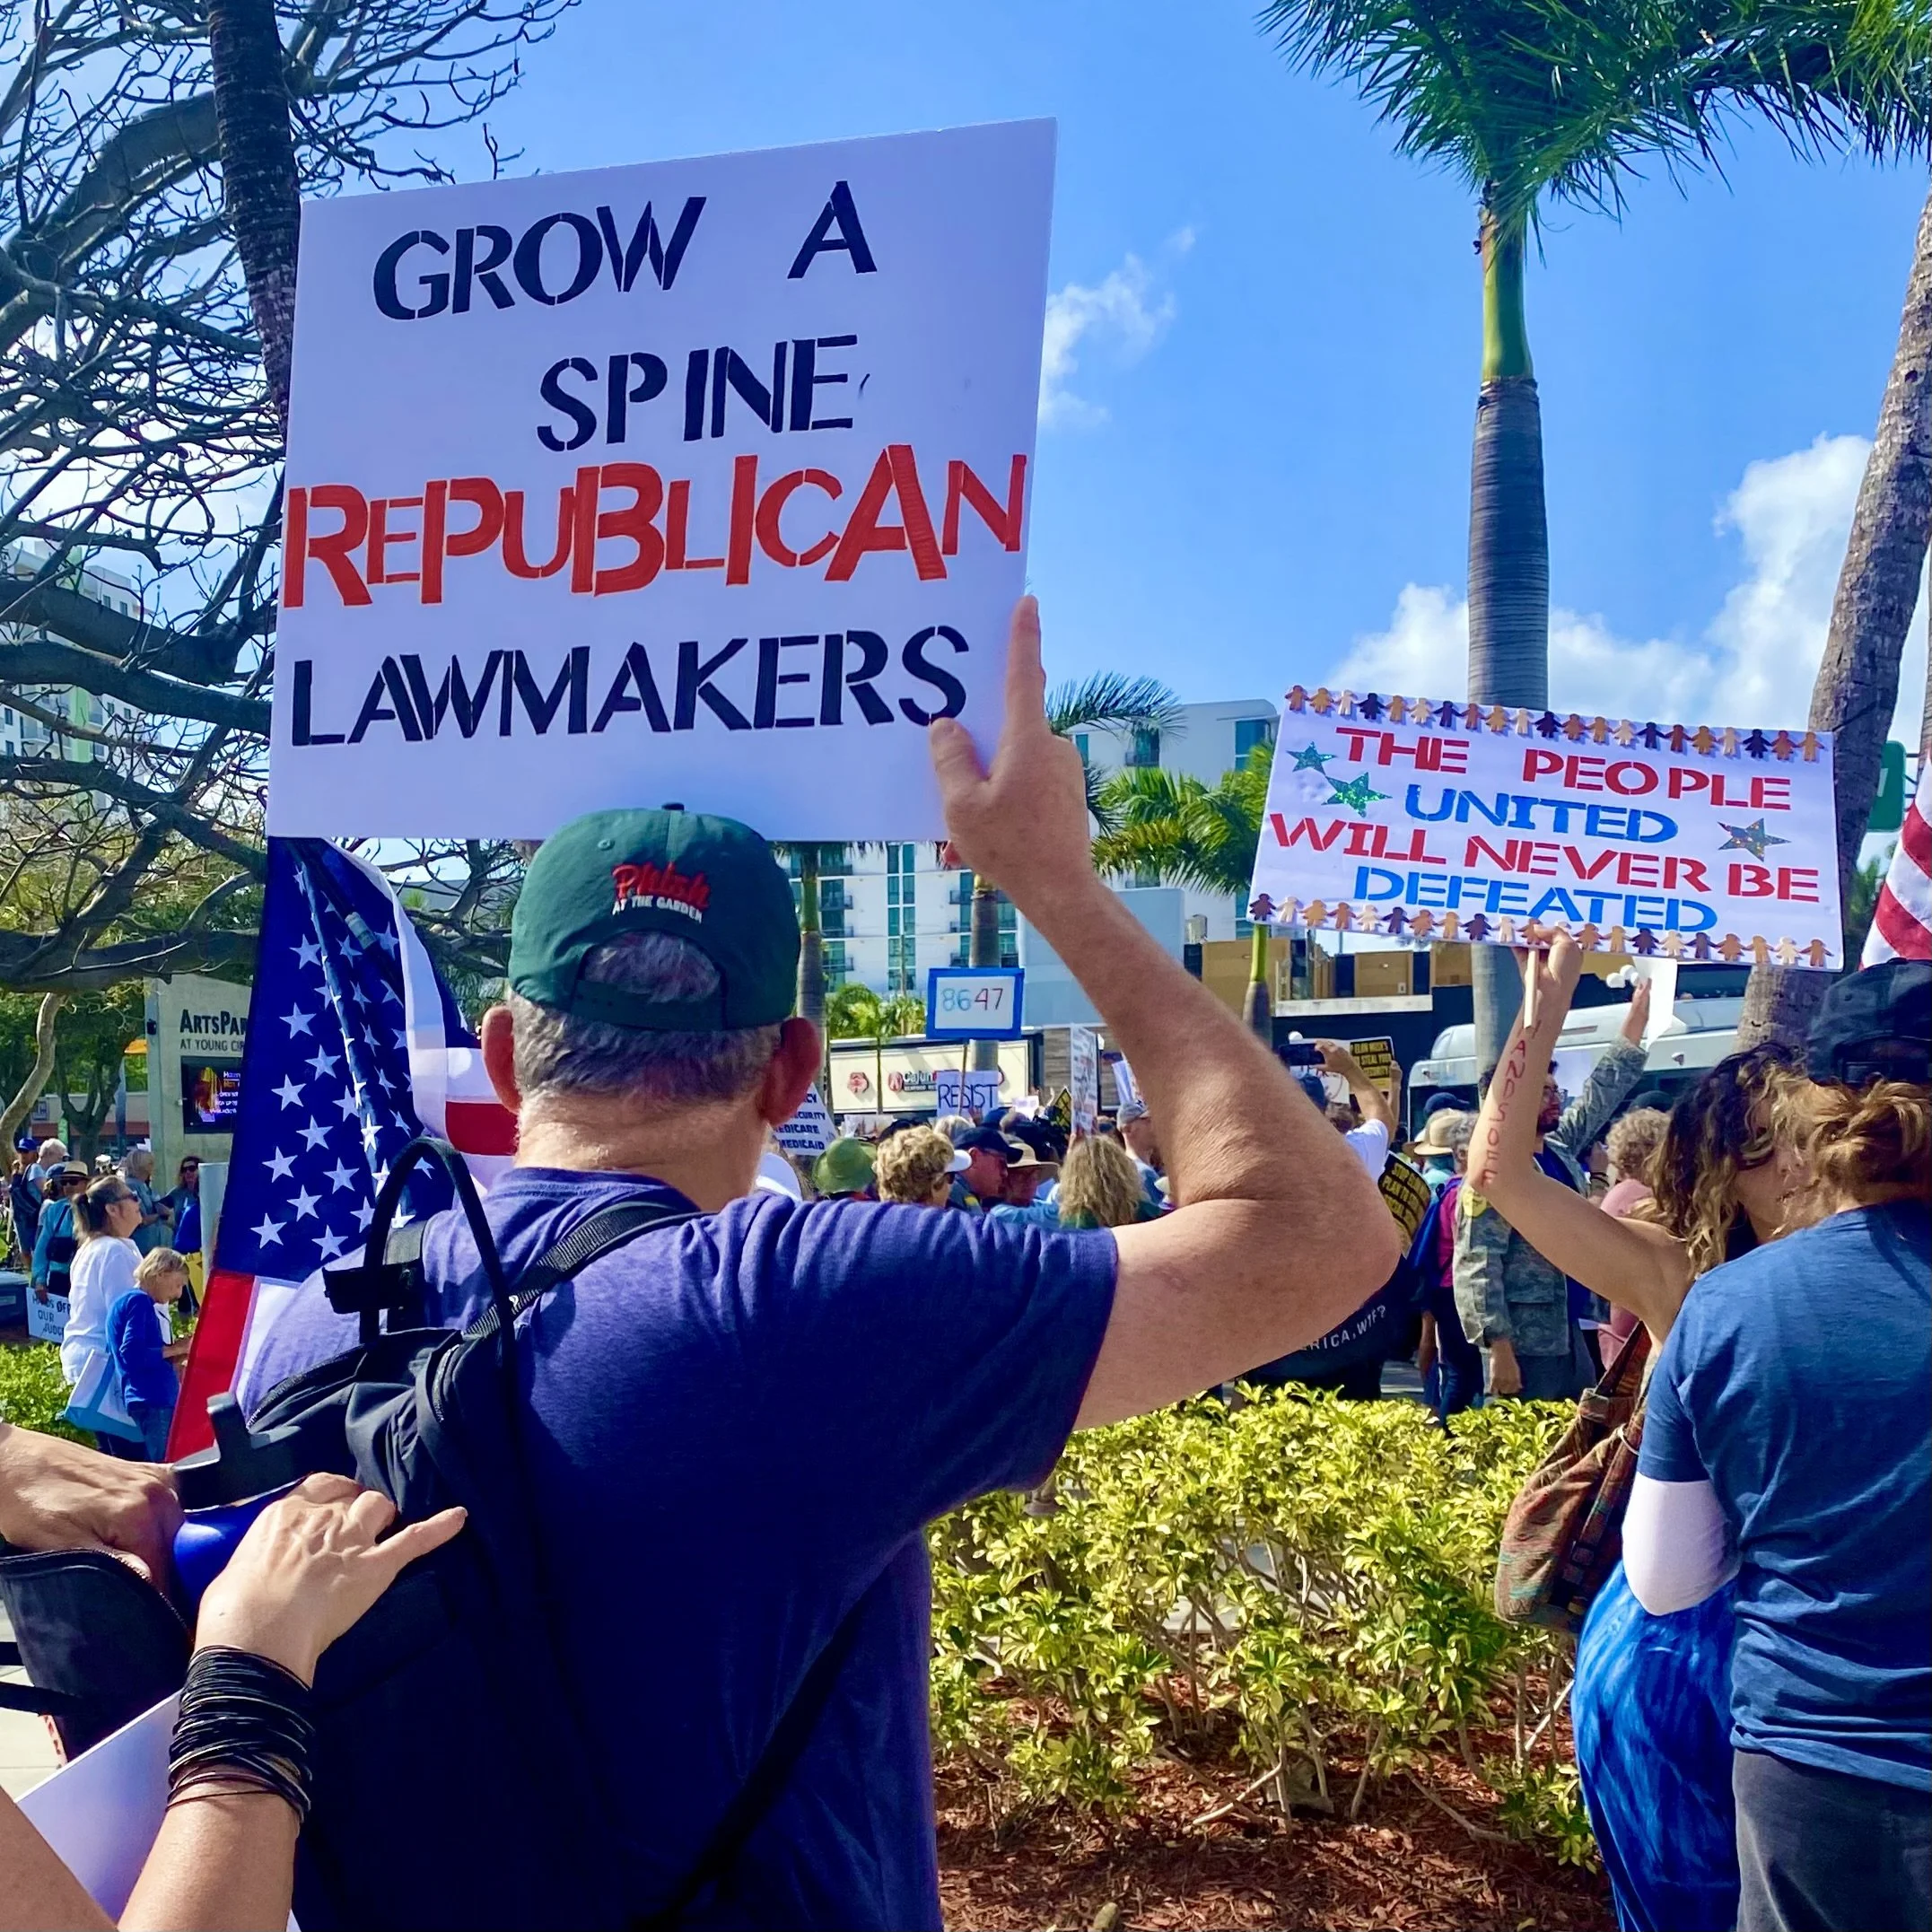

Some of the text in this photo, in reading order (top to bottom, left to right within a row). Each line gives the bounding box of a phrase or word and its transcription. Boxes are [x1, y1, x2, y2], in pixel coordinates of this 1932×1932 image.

[373, 180, 878, 320] GROW A
[537, 334, 858, 451] SPINE
[284, 444, 1027, 608] REPUBLICAN
[292, 625, 969, 747] LAWMAKERS
[1335, 727, 1791, 810] THE PEOPLE
[1405, 783, 1678, 843] UNITED
[1270, 813, 1820, 903] WILL NEVER BE
[632, 896, 653, 908] THE
[657, 896, 702, 922] GARDEN
[1353, 866, 1718, 931] DEFEATED
[942, 988, 1003, 1011] 8647
[180, 1038, 191, 1049] AT
[193, 1039, 228, 1052] YOUNG
[903, 1070, 932, 1084] Cajun
[938, 1084, 998, 1109] RESIST
[38, 1309, 54, 1322] OUR
[42, 1323, 63, 1336] JUDG
